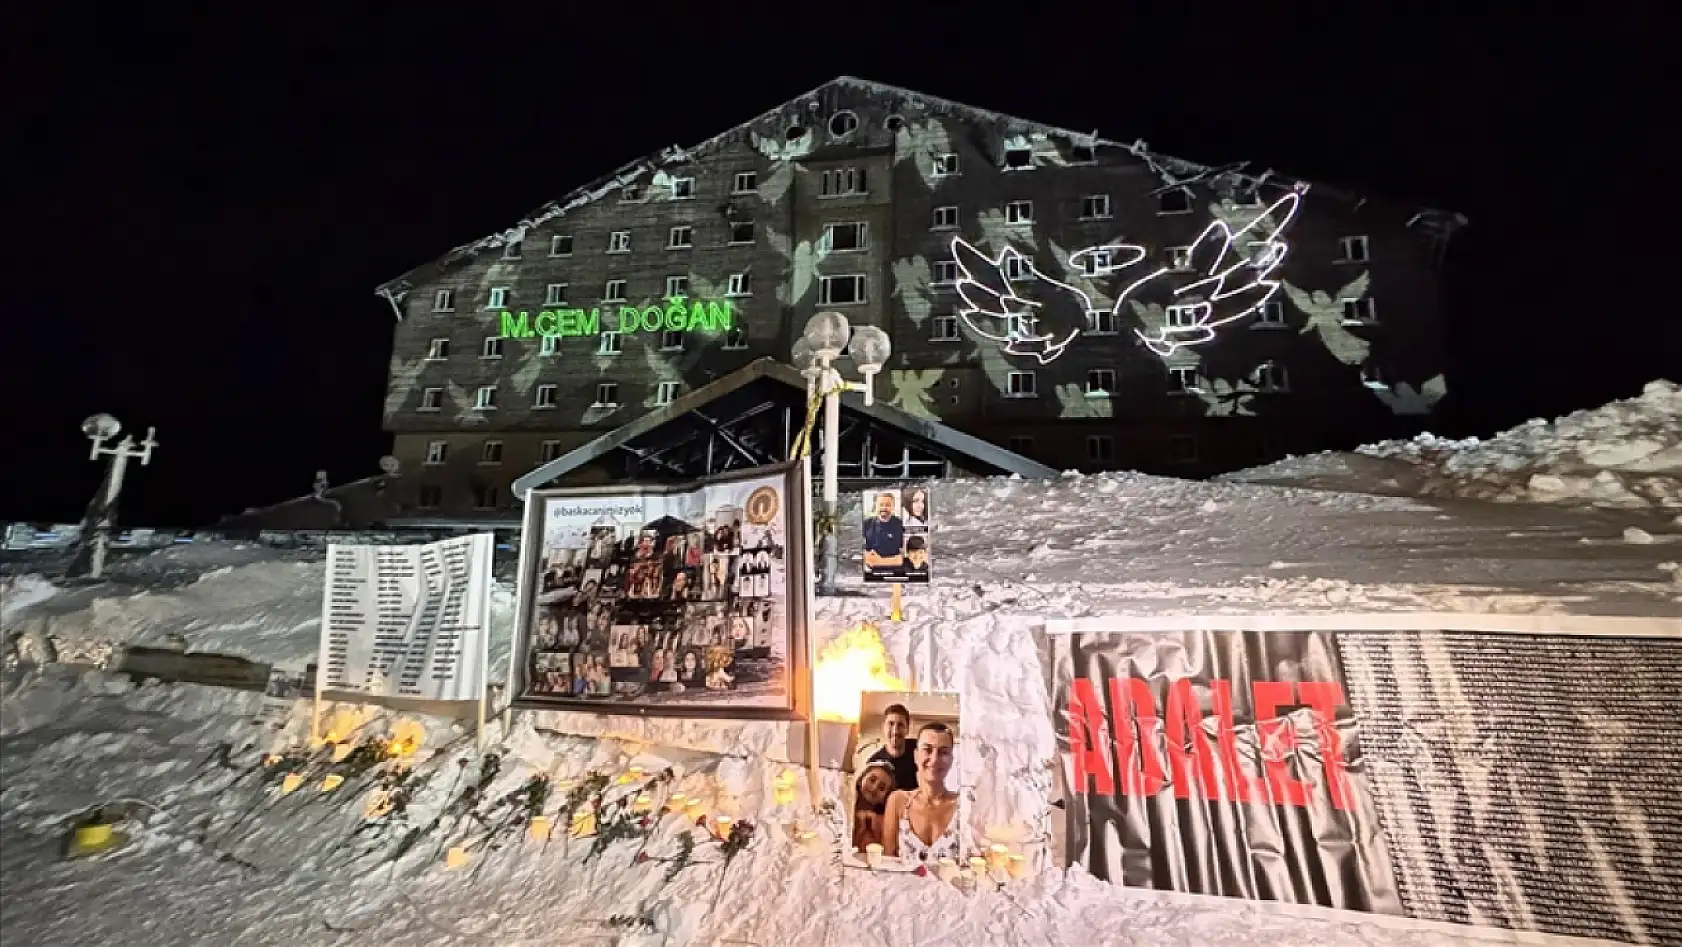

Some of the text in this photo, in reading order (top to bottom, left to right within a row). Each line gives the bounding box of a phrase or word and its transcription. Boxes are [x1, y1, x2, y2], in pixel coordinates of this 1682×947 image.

[500, 297, 733, 338] M.CEM DOĞAN
[1068, 677, 1356, 810] ADALET
